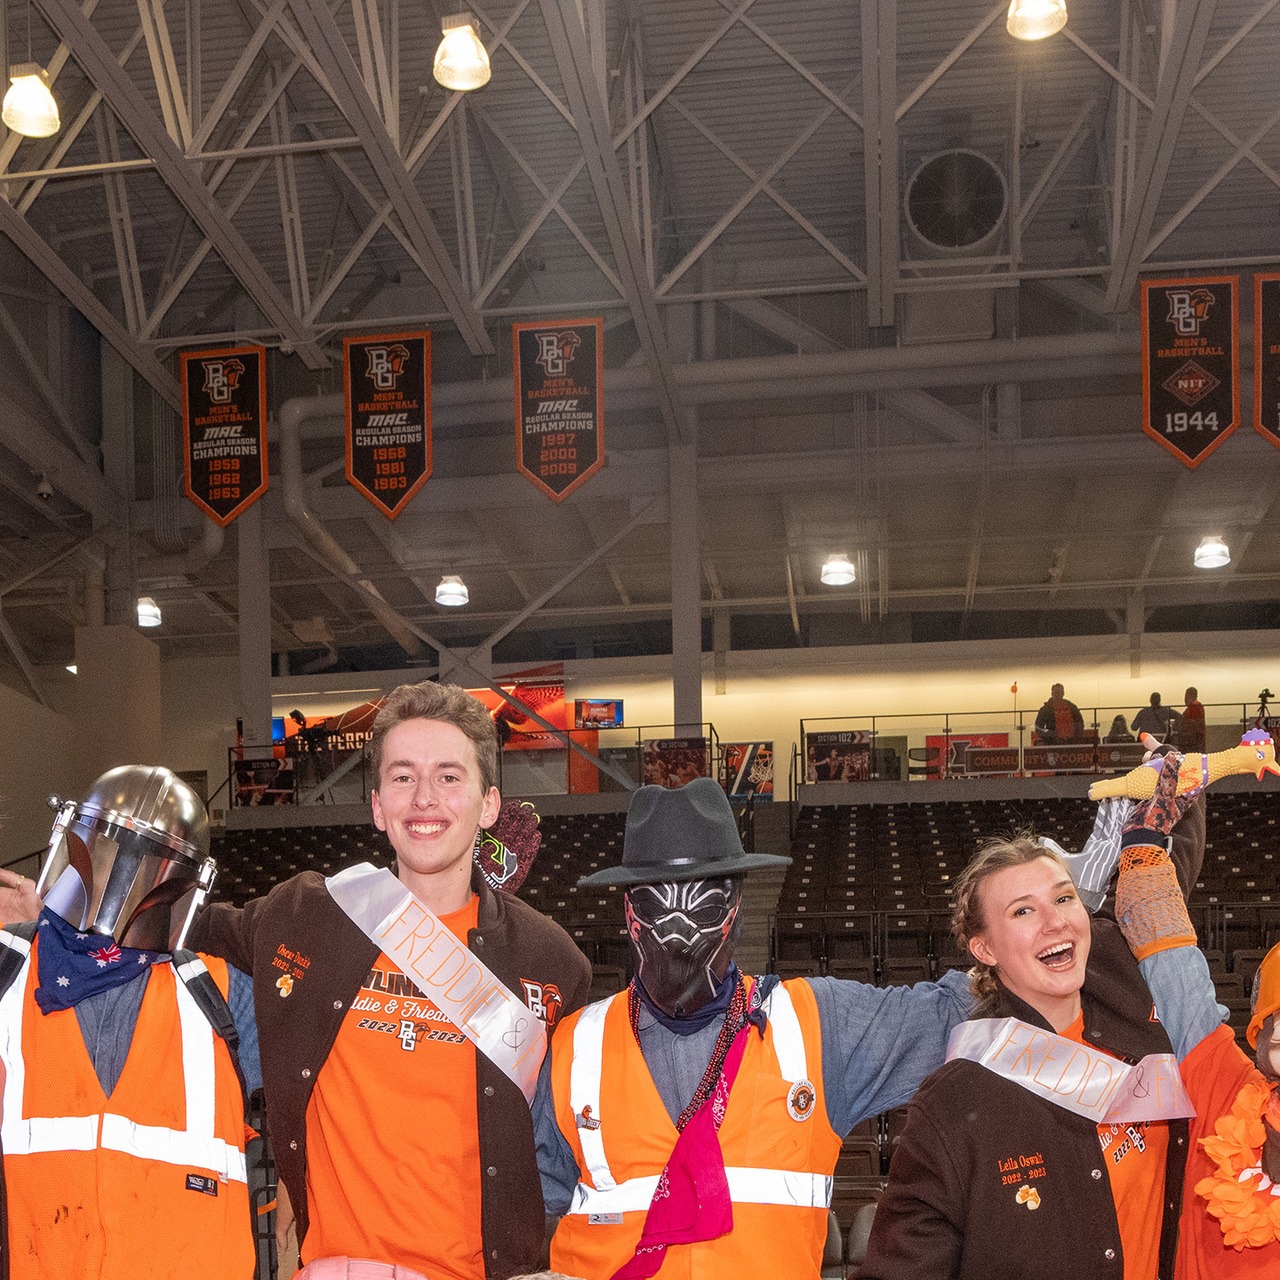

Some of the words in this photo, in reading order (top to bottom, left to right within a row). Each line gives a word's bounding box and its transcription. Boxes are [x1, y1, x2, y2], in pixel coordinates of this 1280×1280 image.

[1174, 337, 1207, 347] MEN'S
[1157, 346, 1224, 358] BASKETBALL
[543, 378, 574, 388] MEN'S
[1178, 379, 1206, 389] NIT
[373, 391, 404, 402] MEN'S
[528, 386, 589, 399] BASKETBALL
[209, 404, 238, 415] MEN'S
[358, 400, 419, 412] BASKETBALL
[537, 399, 578, 414] MAC
[195, 413, 252, 425] BASKETBALL
[367, 413, 408, 426] MAC
[525, 414, 560, 424] REGULAR
[562, 412, 593, 421] SEASON
[1165, 411, 1219, 432] 1944
[204, 425, 243, 440] MAC
[355, 427, 391, 436] REGULAR
[392, 424, 422, 434] SEASON
[525, 420, 594, 434] CHAMPIONS
[193, 440, 225, 449] REGULAR
[227, 437, 256, 445] SEASON
[355, 433, 422, 446] CHAMPIONS
[193, 446, 257, 460] CHAMPIONS
[540, 448, 577, 462] 2000
[209, 473, 240, 485] 1962
[839, 733, 852, 743] 102
[380, 899, 510, 1039] FREDDIE
[502, 1017, 528, 1052] &
[384, 999, 398, 1014] &
[357, 1018, 397, 1033] 2022
[428, 1029, 467, 1044] 2023
[1114, 1138, 1131, 1164] 2022
[1002, 1171, 1022, 1186] 2022
